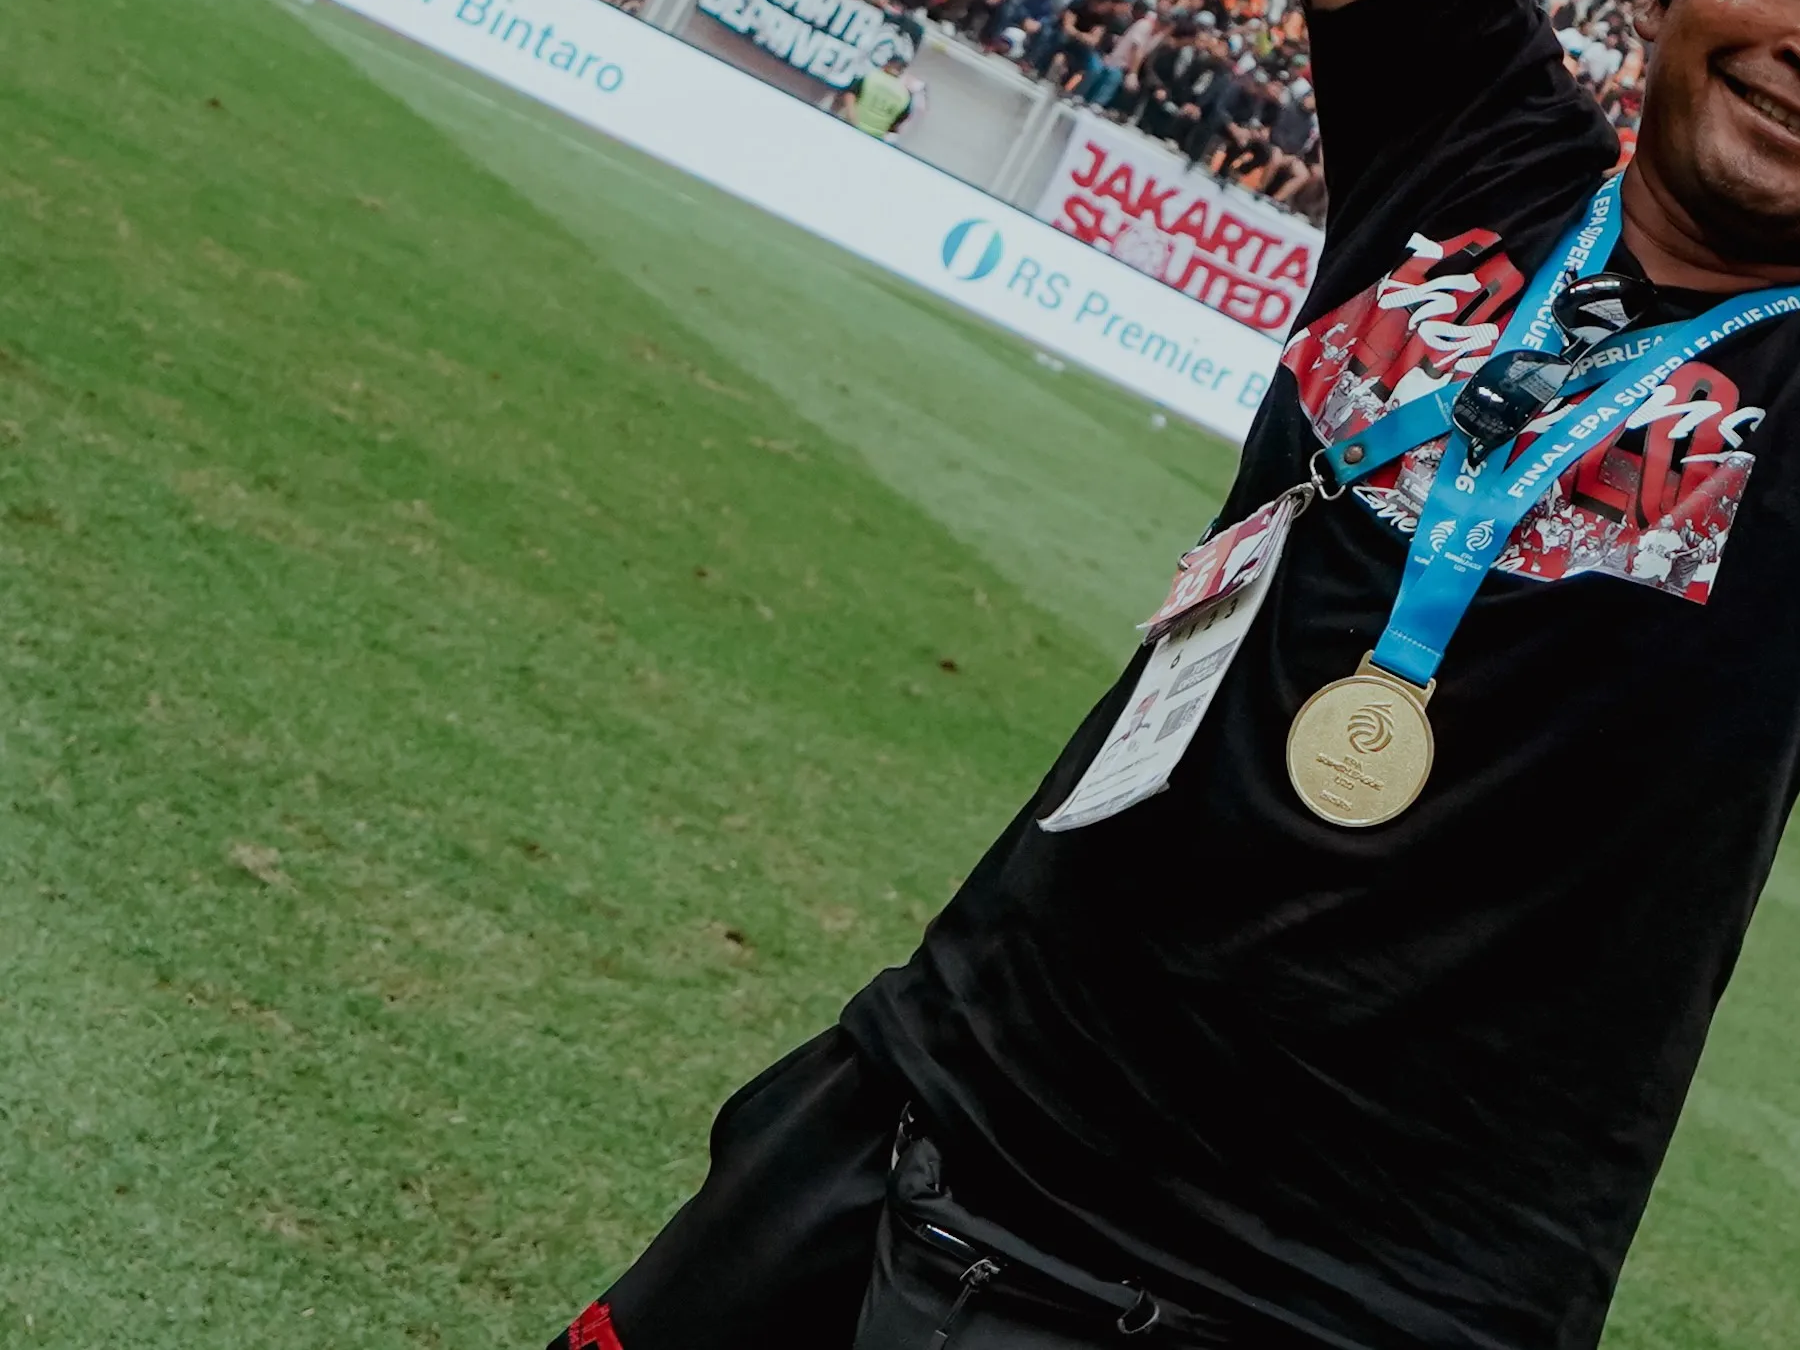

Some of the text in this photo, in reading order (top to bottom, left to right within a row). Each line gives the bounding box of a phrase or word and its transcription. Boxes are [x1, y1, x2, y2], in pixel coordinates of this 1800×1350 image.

[1070, 139, 1312, 289] JAKARTA
[1006, 256, 1270, 410] RS Premier B
[1507, 440, 1576, 499] FINAL
[1568, 405, 1620, 440] EPA
[1614, 354, 1685, 408] SUPER
[1683, 307, 1764, 358] LEAGUE
